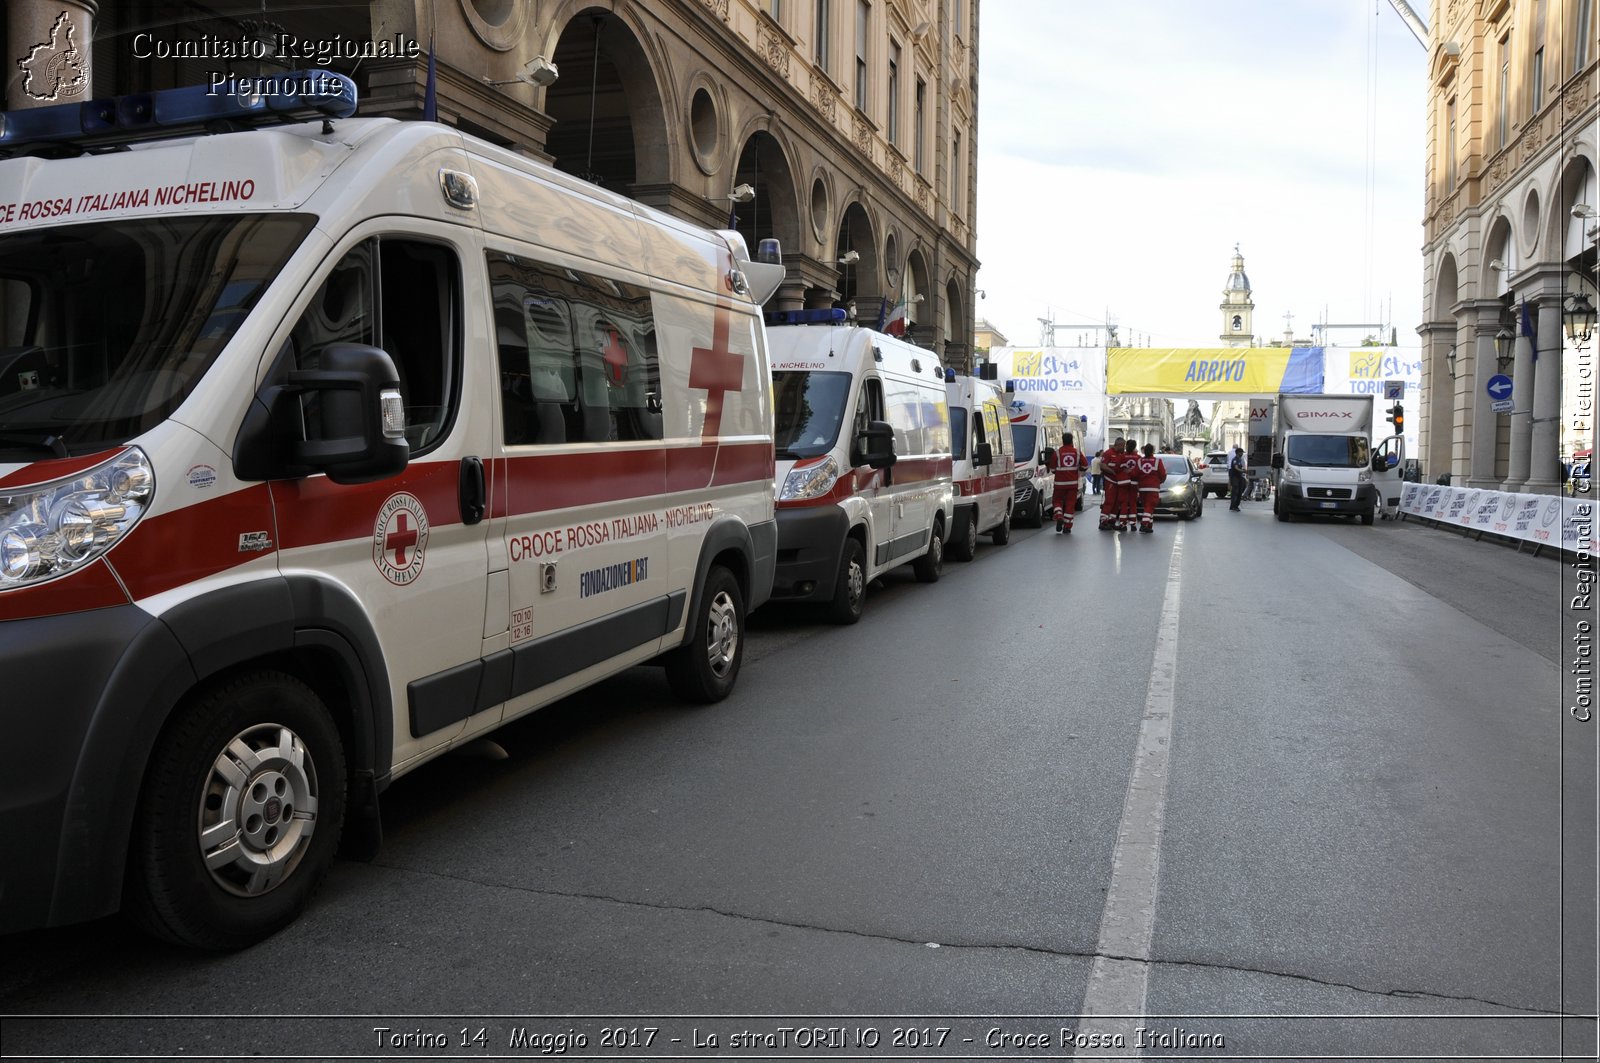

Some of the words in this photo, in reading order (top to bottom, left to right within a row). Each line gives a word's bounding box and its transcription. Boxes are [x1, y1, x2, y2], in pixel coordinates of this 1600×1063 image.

[18, 199, 71, 221] ROSSA
[76, 188, 149, 214] ITALIANA
[153, 179, 255, 206] NICHELINO
[1012, 379, 1059, 392] TORINO
[1184, 360, 1246, 382] ARRIVO
[1297, 411, 1353, 419] GIMAX
[375, 508, 389, 546] CROCE
[386, 496, 407, 513] ROSSA
[509, 529, 563, 562] CROCE
[566, 522, 610, 550] ROSSA
[612, 512, 659, 540] ITALIANA
[665, 502, 714, 529] NICHELINO
[376, 549, 423, 582] NICHELINO
[580, 561, 628, 599] FONDAZIONE
[635, 556, 649, 582] CRT
[512, 612, 522, 624] TO
[524, 609, 531, 621] 10
